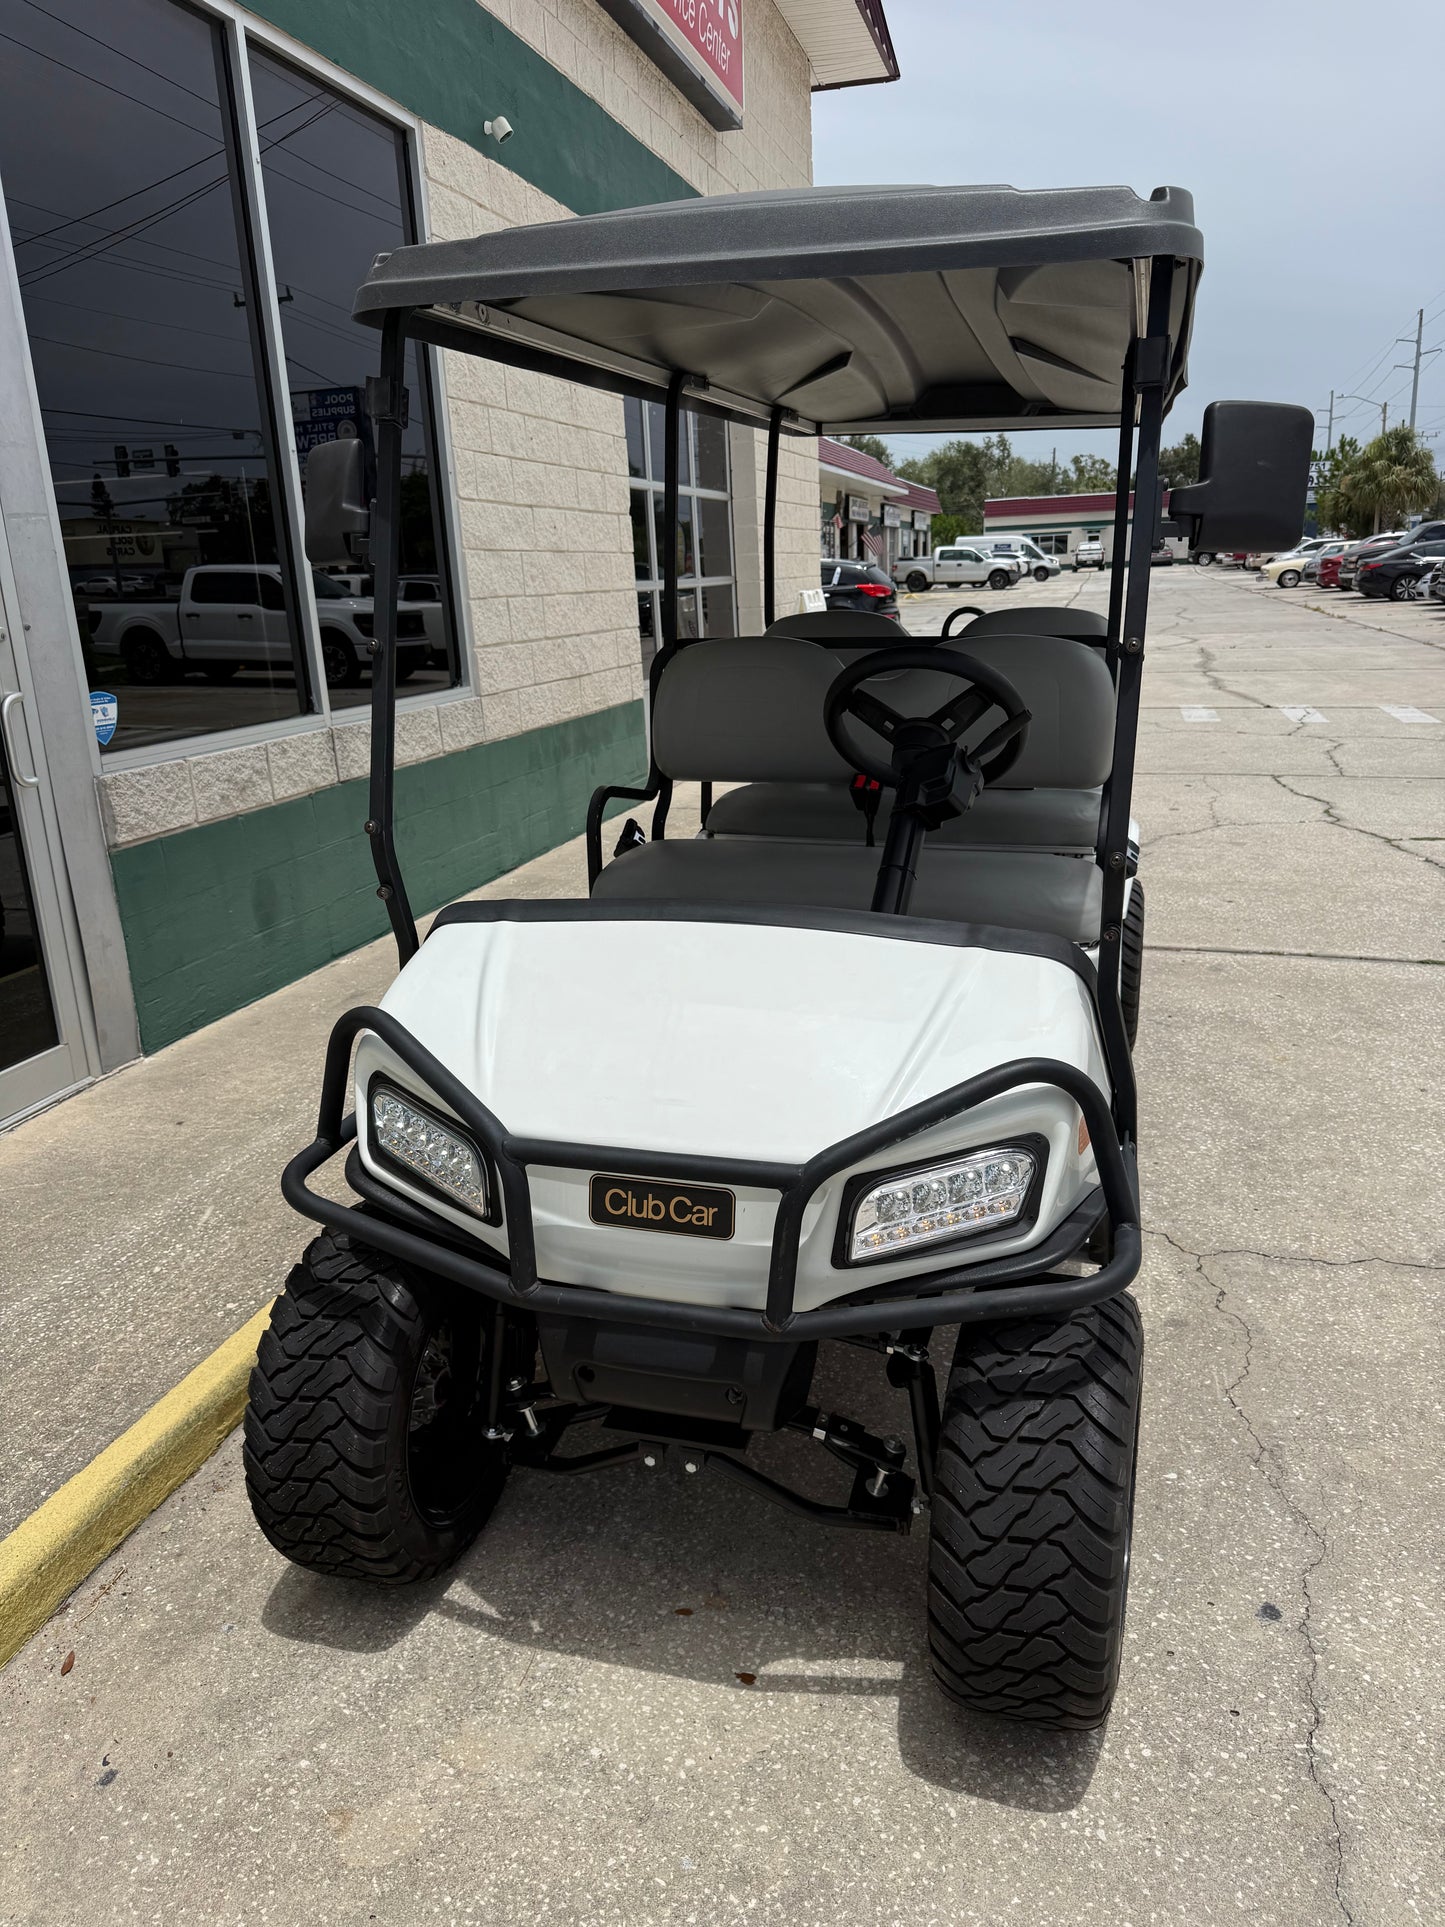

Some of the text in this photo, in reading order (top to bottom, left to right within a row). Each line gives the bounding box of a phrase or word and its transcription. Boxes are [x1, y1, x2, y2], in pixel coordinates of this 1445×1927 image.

[698, 2, 731, 75] Center
[604, 1188, 719, 1227] Club Car
